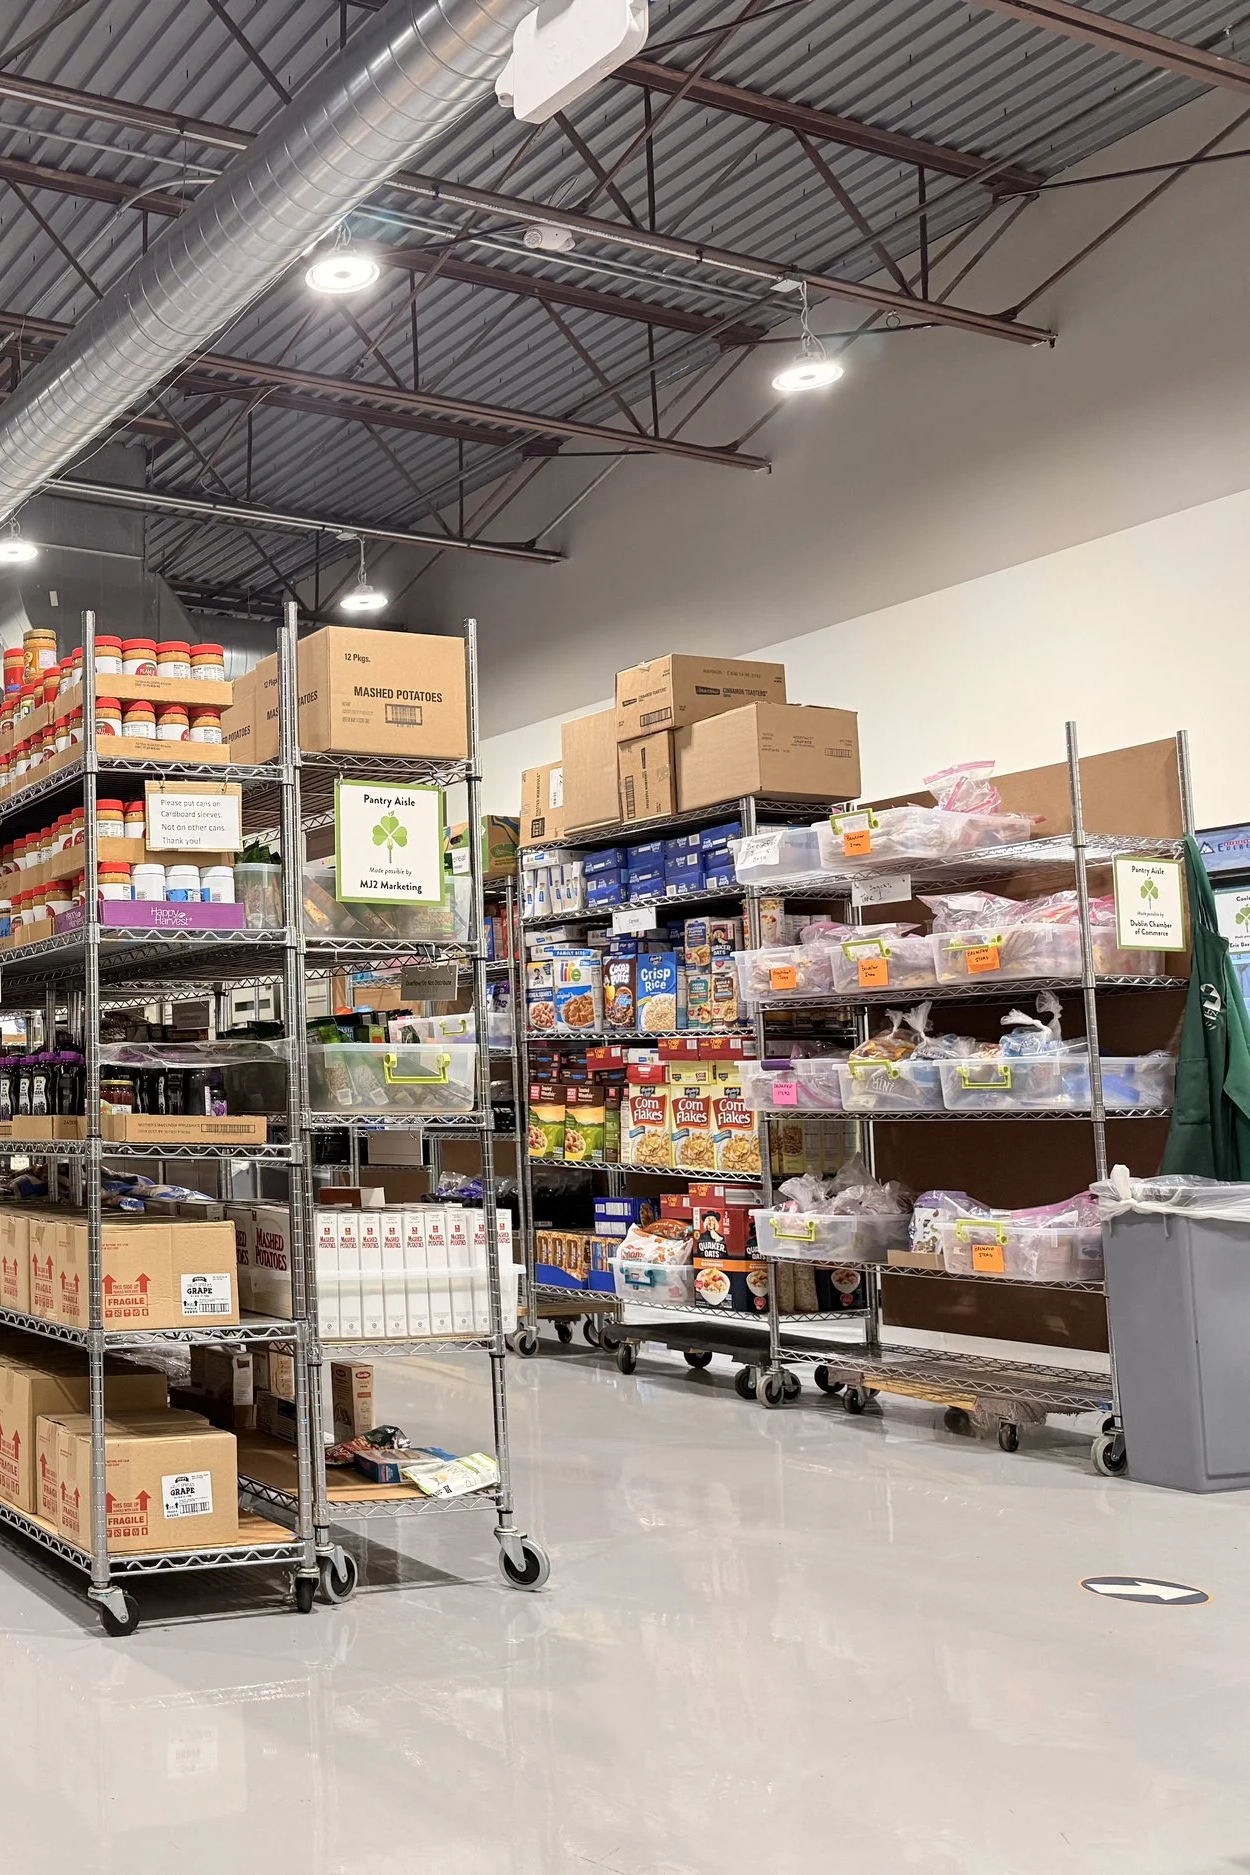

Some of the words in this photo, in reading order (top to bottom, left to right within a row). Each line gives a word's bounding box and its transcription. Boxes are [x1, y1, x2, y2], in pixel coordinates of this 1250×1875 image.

[344, 653, 352, 661] 12
[353, 654, 371, 664] Pkgs.
[354, 686, 394, 699] MASHED
[396, 690, 443, 702] POTATOES
[266, 709, 280, 720] MAS
[228, 725, 250, 743] POTATOES
[184, 800, 194, 808] put
[364, 794, 392, 808] Pantry
[394, 797, 416, 806] Aisle
[1132, 866, 1150, 876] Pantry
[1150, 867, 1164, 875] Aisle
[360, 880, 378, 889] MJ2
[380, 880, 422, 894] Marketing
[151, 907, 178, 918] Happy
[155, 916, 188, 926] Harvest
[560, 962, 582, 982] life
[640, 968, 671, 982] Crisp
[645, 980, 666, 992] Rice
[635, 1098, 659, 1109] Corn
[678, 1098, 704, 1110] Corn
[718, 1099, 745, 1112] Corn
[634, 1109, 662, 1122] Flakes
[676, 1110, 708, 1124] Flakes
[718, 1112, 750, 1126] Flakes
[236, 1230, 246, 1248] HED
[256, 1228, 284, 1252] MASHED
[255, 1246, 287, 1272] POTATOES
[704, 1250, 720, 1258] OATS
[36, 1283, 52, 1294] FRAGILE
[187, 1287, 212, 1295] GRAPE
[108, 1297, 145, 1306] FRAGILE
[44, 1484, 57, 1498] FRAGI
[170, 1487, 195, 1496] GRAPE
[63, 1506, 78, 1520] FRAGILE
[108, 1516, 144, 1525] FRAGILE
